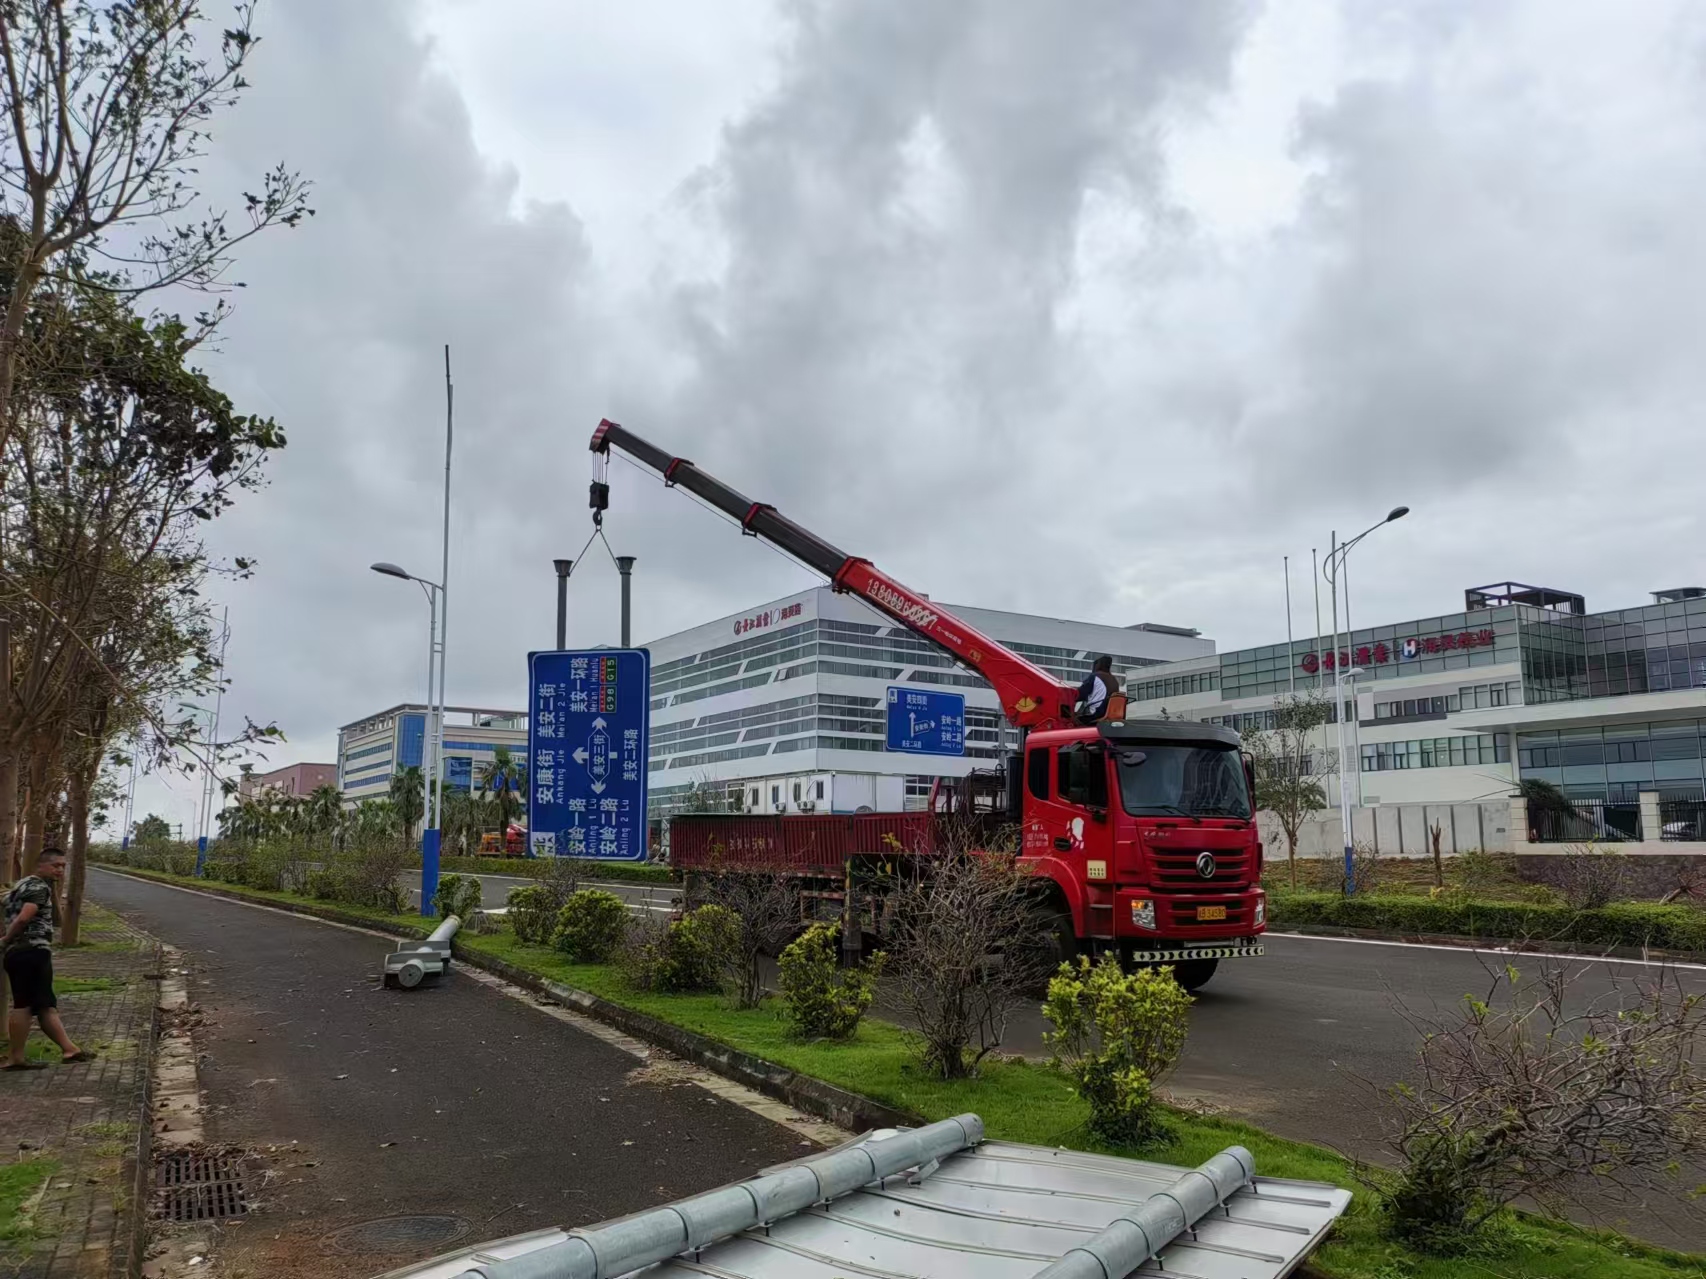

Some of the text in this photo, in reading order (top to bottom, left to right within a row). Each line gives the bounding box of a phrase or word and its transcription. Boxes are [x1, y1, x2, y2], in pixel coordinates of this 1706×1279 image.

[569, 657, 588, 713] 美安一环路
[606, 659, 614, 681] G15
[558, 682, 566, 696] Jie
[606, 688, 614, 711] G98
[537, 683, 556, 738] 美安二街
[557, 711, 566, 738] Mei'an
[593, 734, 605, 775] 美安三街
[623, 728, 638, 781] 美安二环路
[537, 749, 554, 804] 安康街
[556, 749, 566, 804] Ankang Jie
[589, 798, 596, 809] Lu
[621, 799, 629, 811] Lu
[568, 797, 586, 854] 安岭一路
[588, 825, 598, 855] Anling
[600, 797, 618, 854] 安岭二路
[621, 827, 630, 855] Anling
